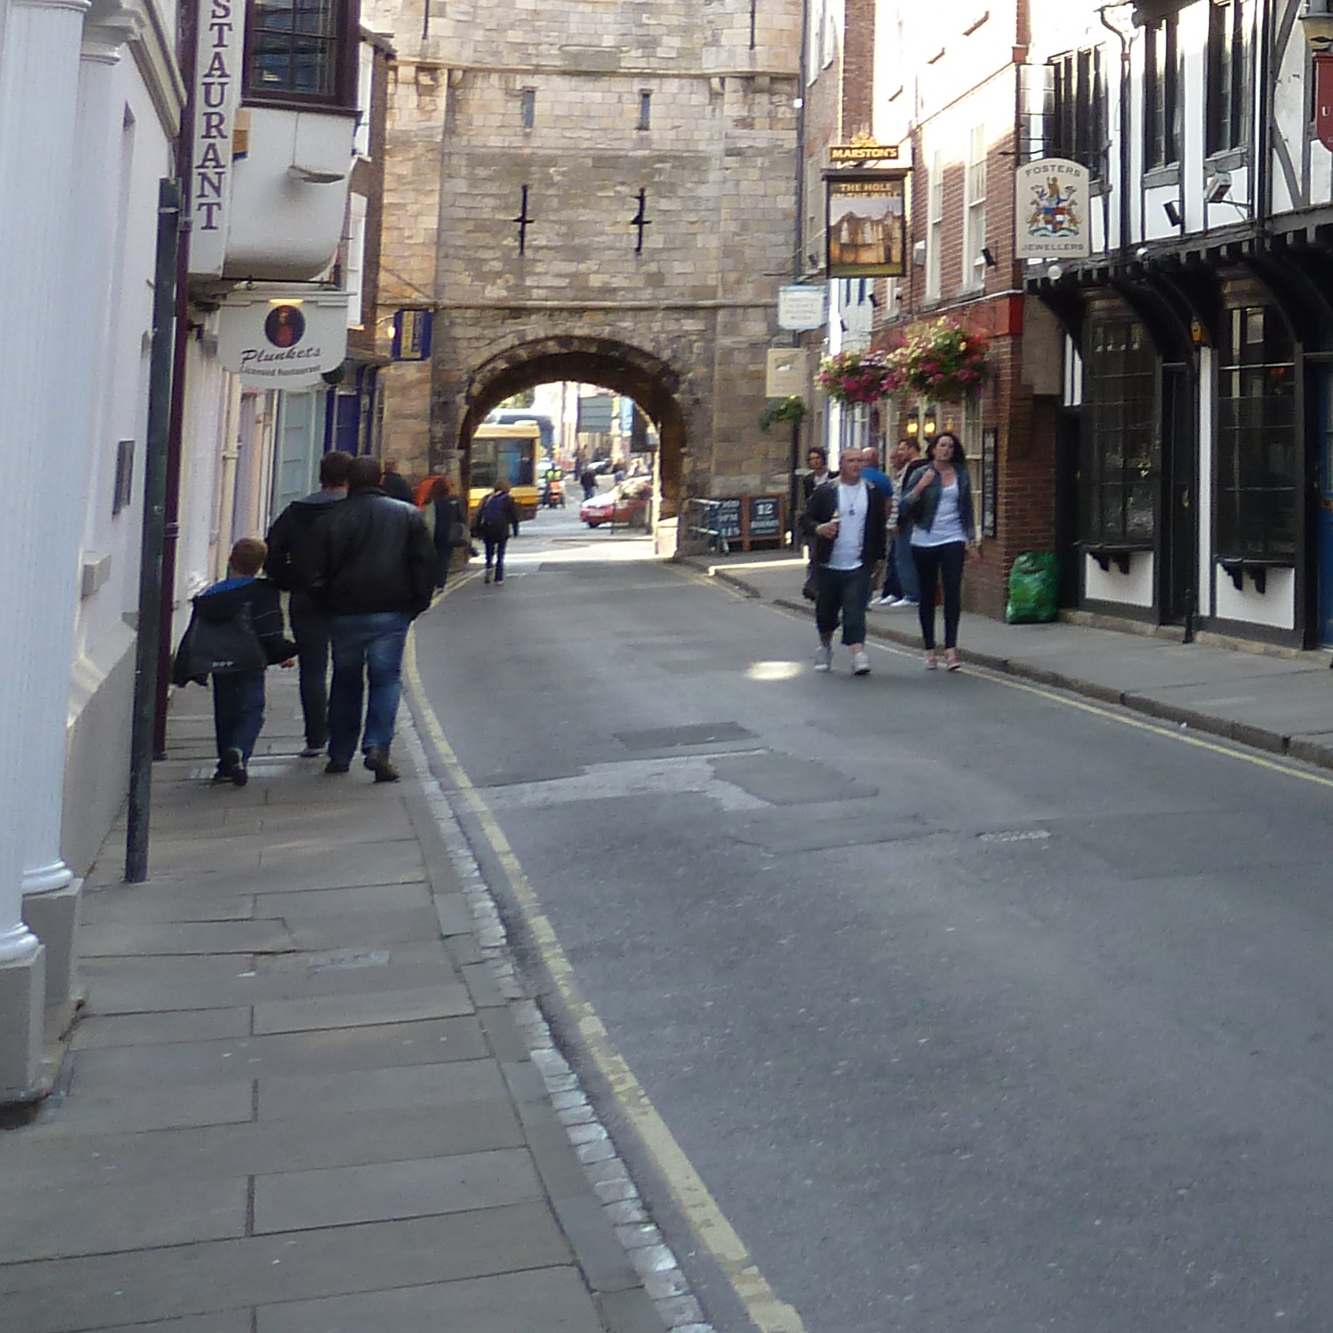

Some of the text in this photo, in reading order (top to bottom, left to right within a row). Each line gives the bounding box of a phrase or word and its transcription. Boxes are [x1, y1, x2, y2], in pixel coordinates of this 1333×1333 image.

[832, 148, 897, 159] MARSTON'S
[1026, 164, 1080, 177] FOSTERS
[840, 183, 892, 192] THE HOLE
[1022, 243, 1084, 251] JEWELLERS
[241, 347, 321, 364] Plunkets
[757, 503, 774, 515] 12
